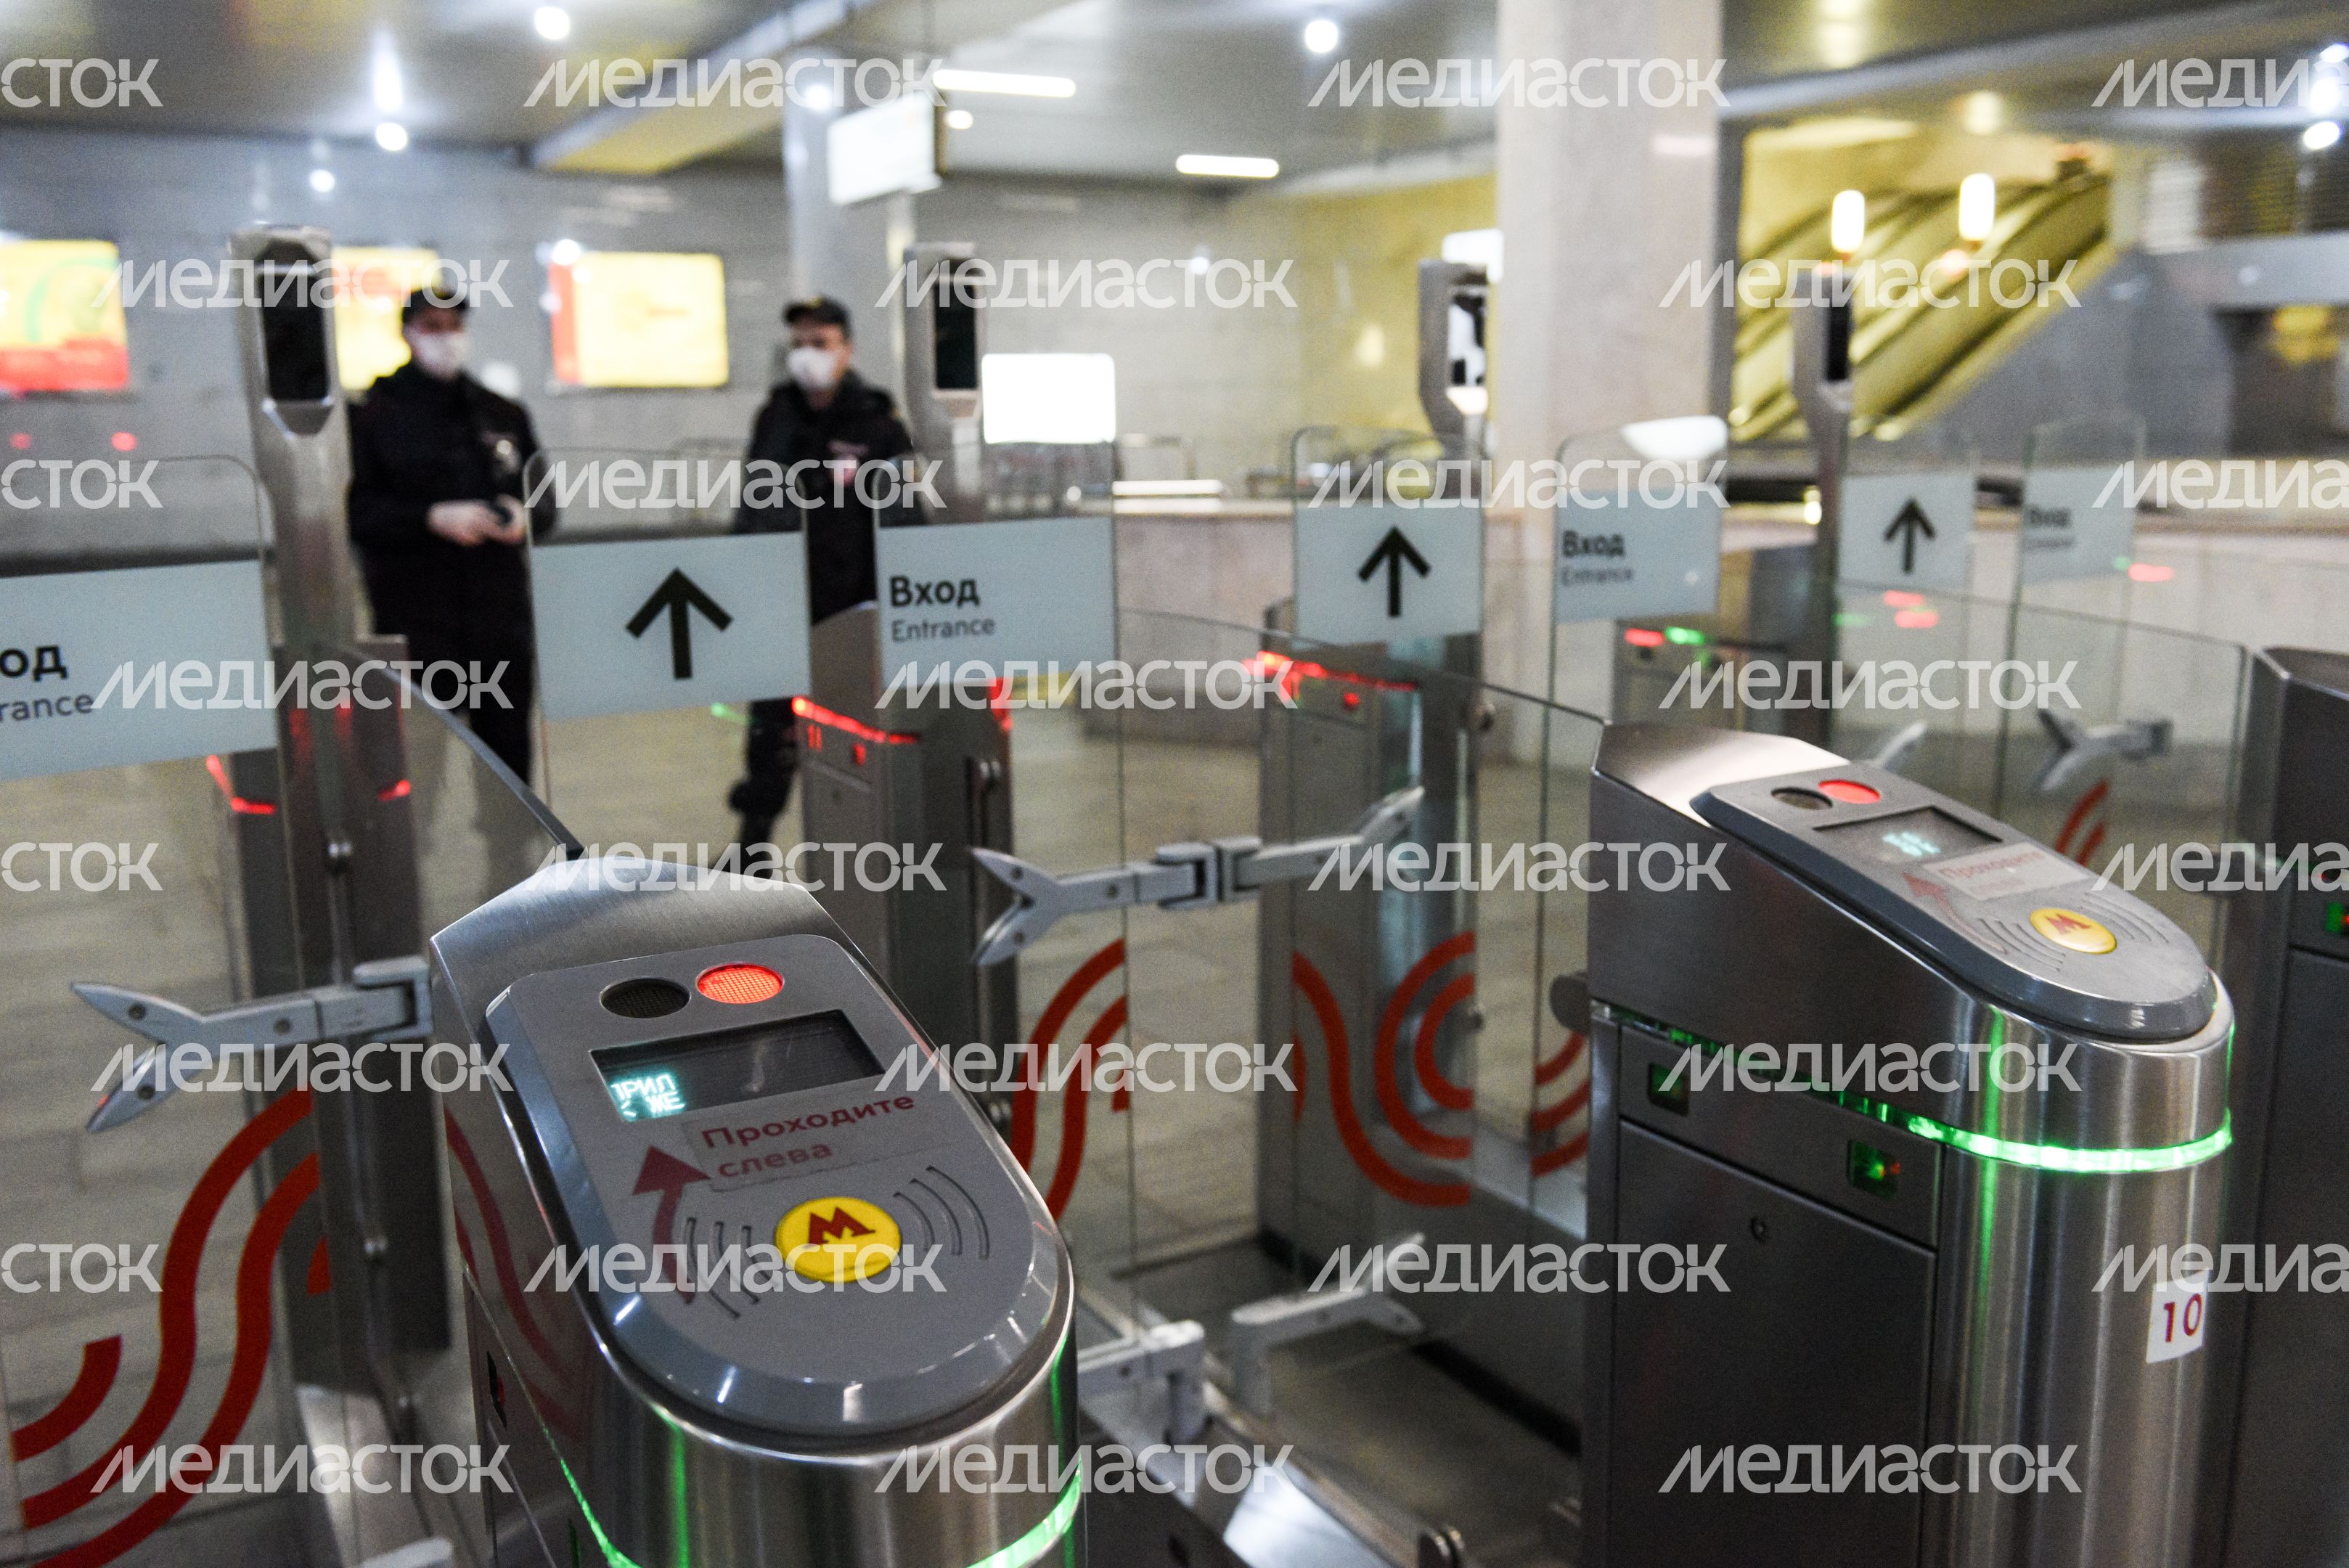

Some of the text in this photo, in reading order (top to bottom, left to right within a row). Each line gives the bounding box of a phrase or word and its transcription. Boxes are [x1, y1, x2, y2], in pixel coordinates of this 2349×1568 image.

[890, 575, 981, 608] Вход
[892, 618, 994, 642] Entrance
[701, 1095, 915, 1148] Проходите
[718, 1143, 833, 1178] слева
[2163, 1293, 2202, 1344] 10
